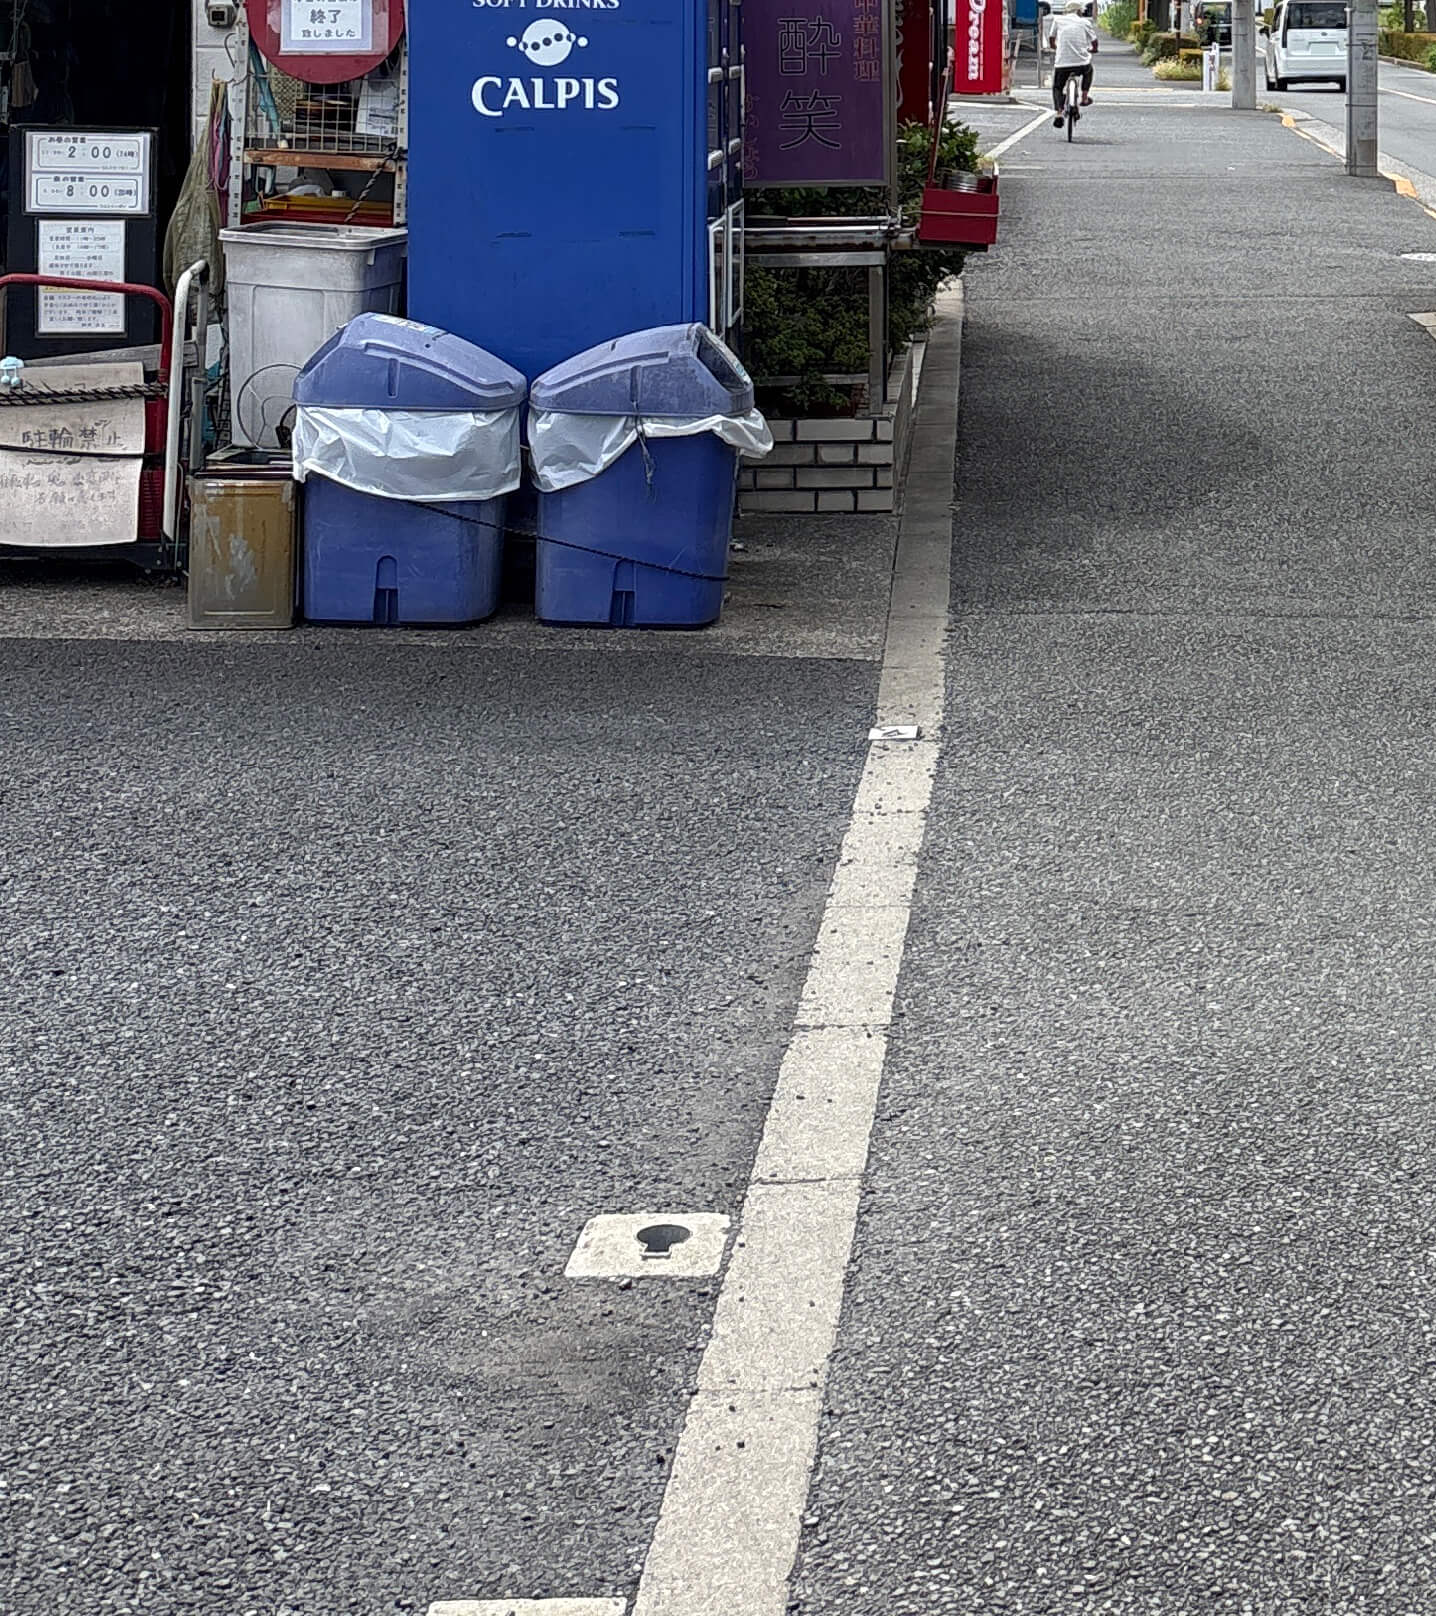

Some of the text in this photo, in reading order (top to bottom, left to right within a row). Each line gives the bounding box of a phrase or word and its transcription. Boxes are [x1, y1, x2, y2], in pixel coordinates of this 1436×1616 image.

[310, 9, 341, 24] 終了
[302, 29, 356, 38] 致しました
[853, 0, 880, 81] 中華料理
[471, 76, 619, 117] CALPIS
[777, 16, 841, 150] 酔笑
[22, 427, 122, 449] 駐輪禁止
